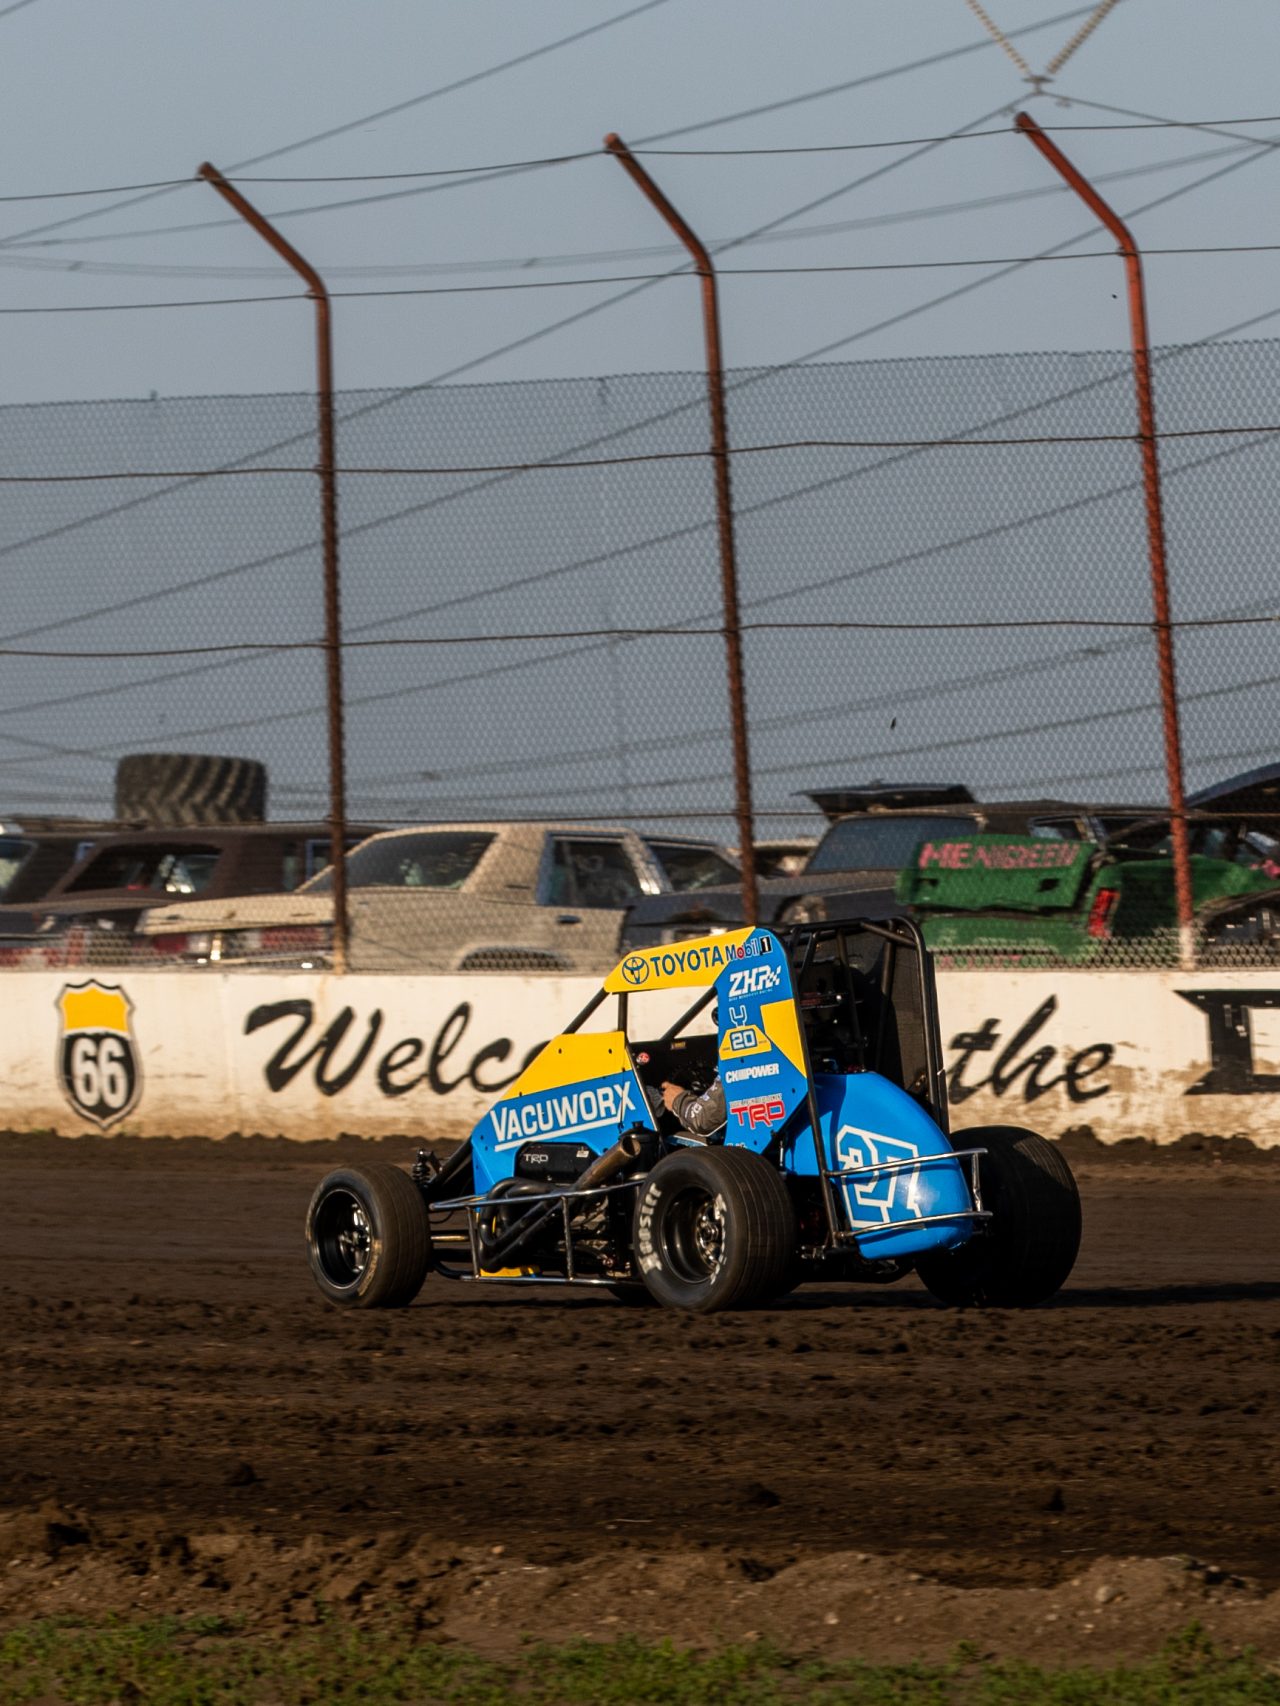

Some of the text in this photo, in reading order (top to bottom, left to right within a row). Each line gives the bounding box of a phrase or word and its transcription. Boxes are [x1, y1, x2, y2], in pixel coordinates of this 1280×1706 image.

[650, 945, 724, 977] TOYOTA
[725, 935, 772, 962] Mobil 1
[730, 1029, 757, 1051] 20
[947, 994, 1114, 1105] the
[72, 1037, 128, 1109] 66
[489, 1081, 636, 1142] VACUWORX
[730, 1101, 786, 1130] TRD
[523, 1152, 549, 1165] TRD
